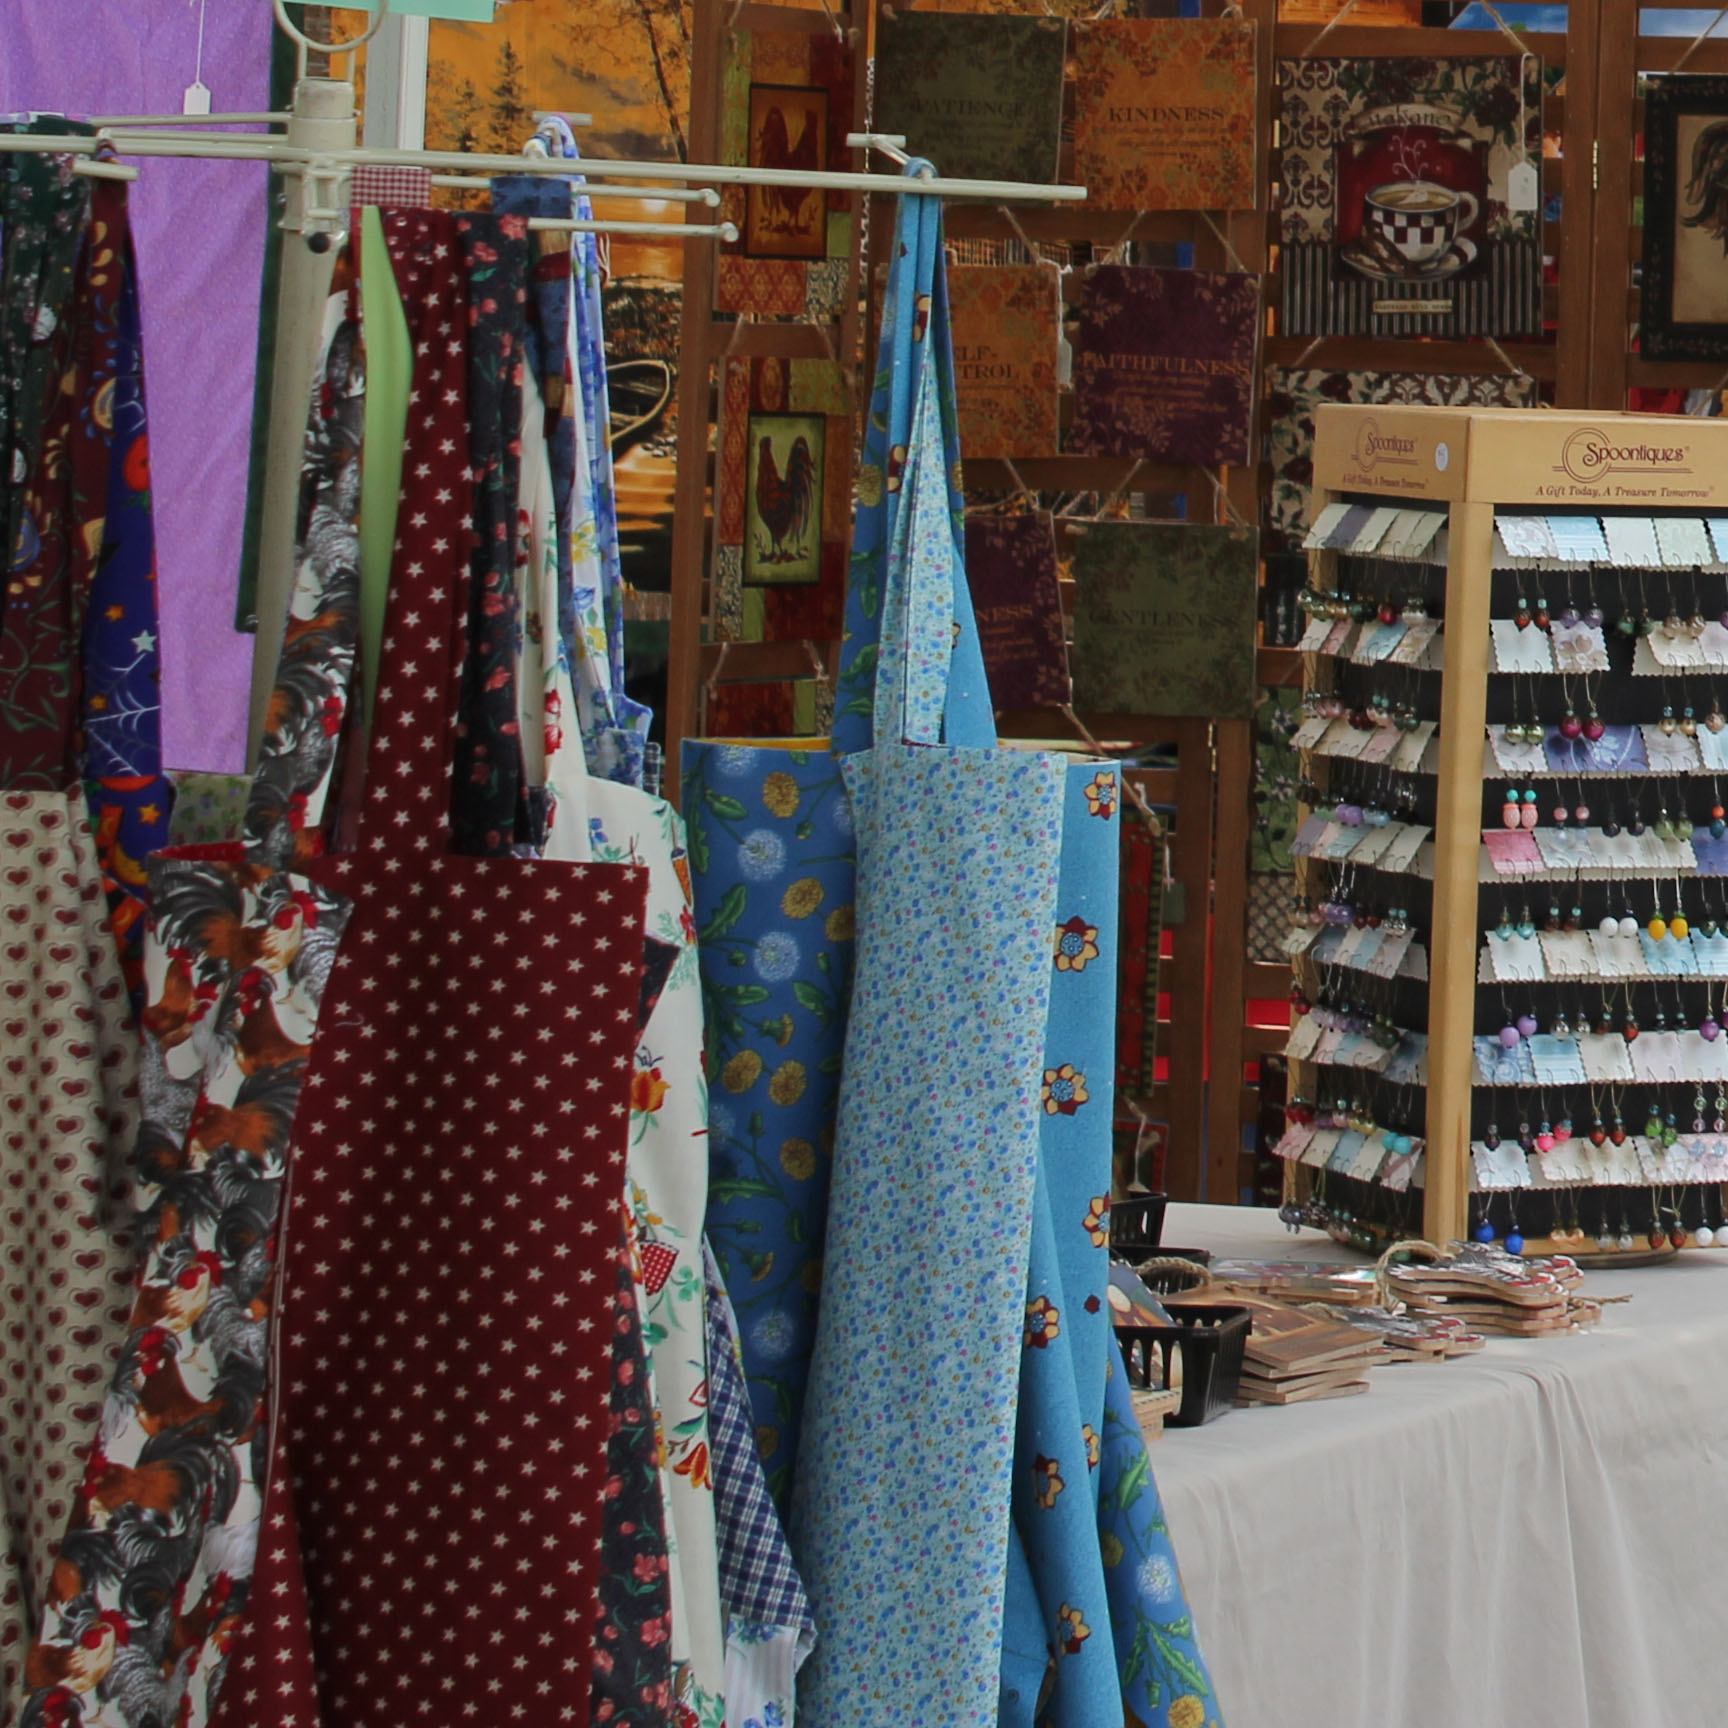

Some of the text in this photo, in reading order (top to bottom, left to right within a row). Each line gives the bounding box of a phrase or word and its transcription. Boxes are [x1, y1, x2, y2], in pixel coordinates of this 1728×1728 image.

[1108, 106, 1225, 123] KINDNESS
[1080, 351, 1252, 376] FAITHFULNESS
[1582, 441, 1685, 466] Spoontiques
[1535, 485, 1545, 496] A
[1546, 485, 1566, 498] Gift
[1603, 486, 1611, 497] A
[1615, 486, 1657, 498] Treasure
[1660, 486, 1710, 498] Tomorrow
